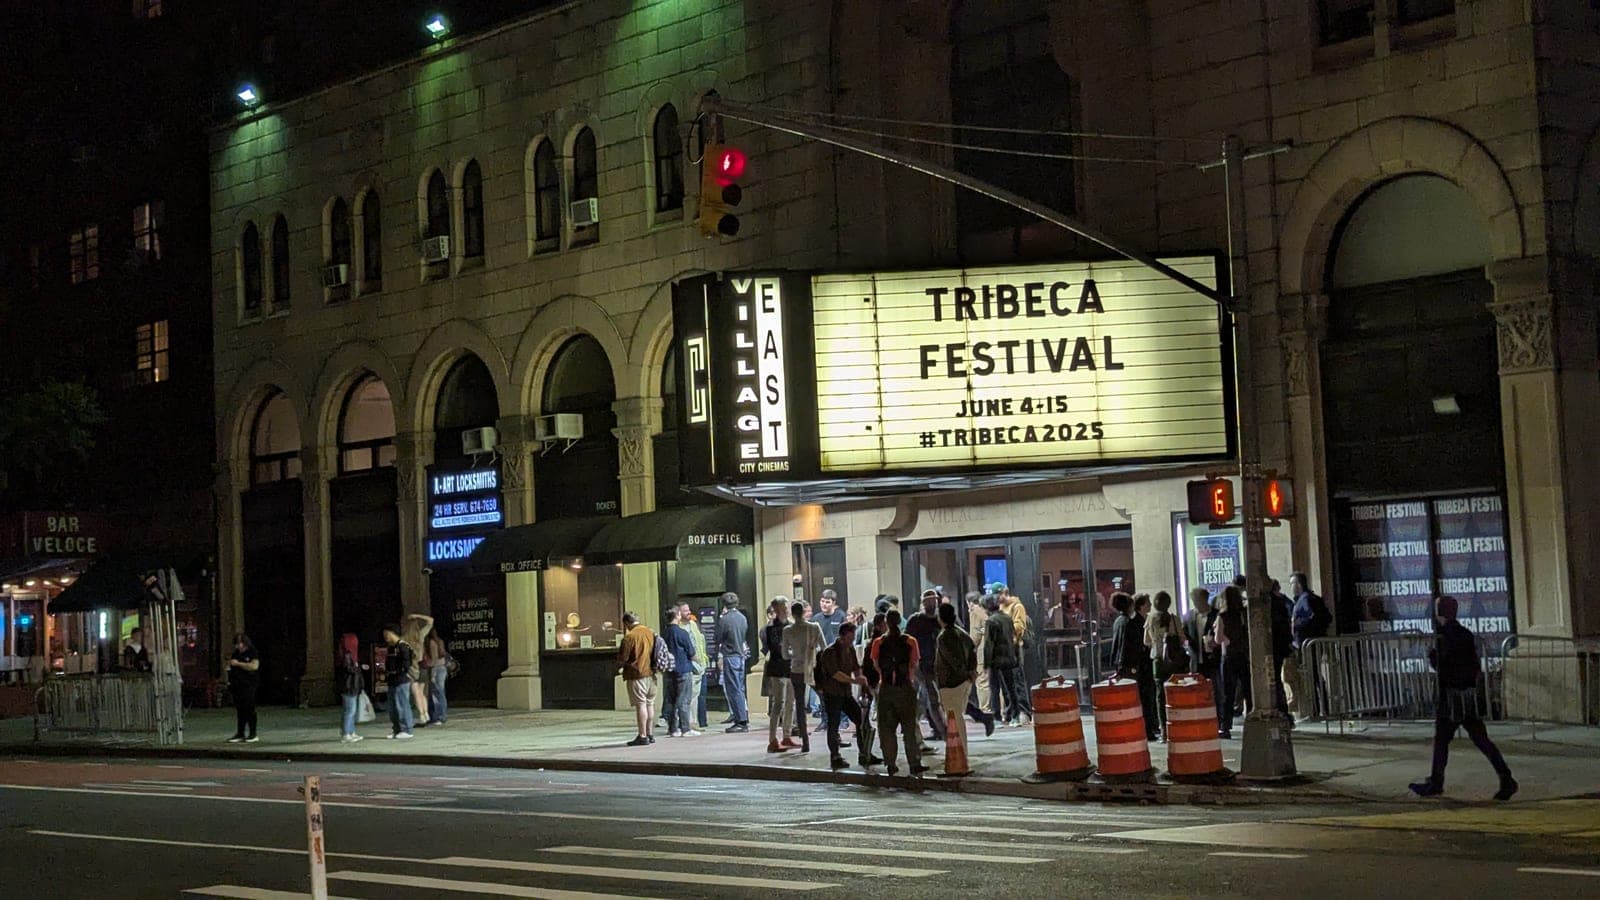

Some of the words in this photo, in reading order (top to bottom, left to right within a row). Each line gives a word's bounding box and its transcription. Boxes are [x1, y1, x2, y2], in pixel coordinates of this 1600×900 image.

[925, 279, 1105, 322] TRIBECA
[920, 336, 1125, 380] FESTIVAL
[731, 279, 760, 459] VILLAGE
[761, 284, 783, 452] EAST
[956, 399, 1014, 418] JUNE
[919, 422, 1104, 448] #TRIBECA2025
[739, 462, 756, 473] CITY
[758, 461, 789, 472] CINEMAS
[456, 470, 497, 492] LOCKSMITHS
[434, 504, 443, 517] 24
[1215, 488, 1225, 515] 6
[1433, 498, 1470, 516] TRIBECA
[1351, 504, 1385, 521] TRIBECA
[1386, 502, 1427, 519] FESTIVAL
[47, 516, 79, 533] BAR
[33, 537, 97, 553] VELOCE
[688, 535, 706, 545] BOX
[707, 534, 743, 545] OFFICE
[1436, 538, 1473, 555] TRIBECA
[1352, 543, 1388, 560] TRIBECA
[1388, 540, 1430, 557] FESTIVAL
[500, 562, 515, 572] BOX
[517, 560, 542, 571] OFFICE
[1202, 557, 1234, 572] TRIBECA
[1355, 581, 1391, 598] TRIBECA
[1391, 579, 1432, 596] FESTIVAL
[1438, 577, 1475, 594] TRIBECA
[457, 622, 489, 634] SERVICE
[1392, 618, 1434, 634] FESTIVAL
